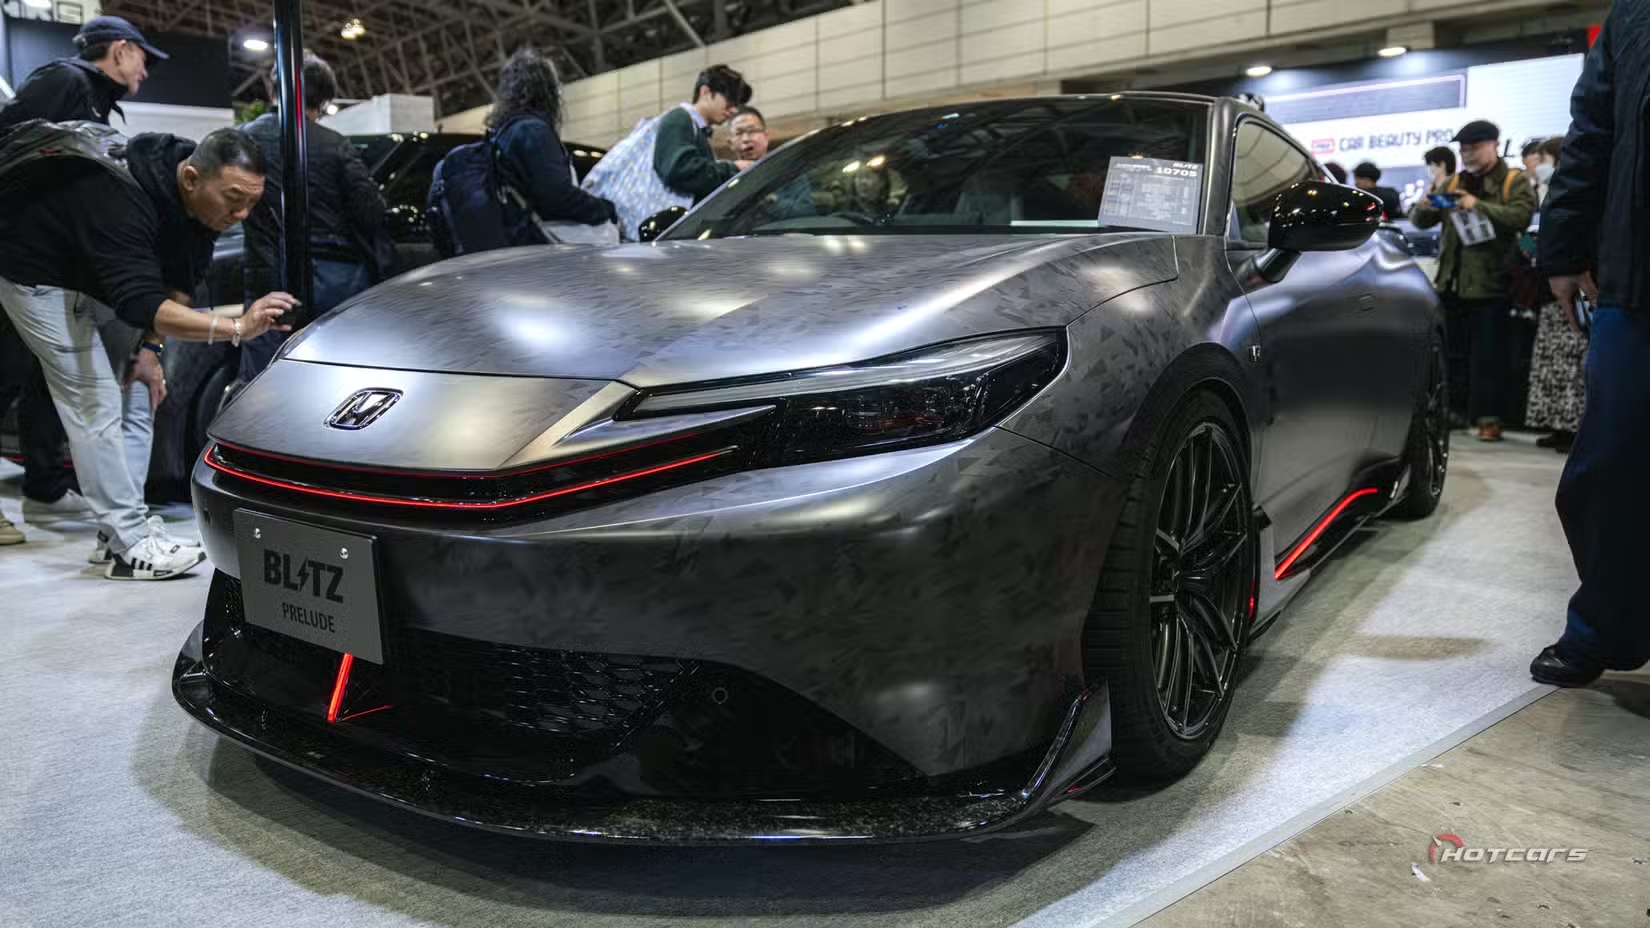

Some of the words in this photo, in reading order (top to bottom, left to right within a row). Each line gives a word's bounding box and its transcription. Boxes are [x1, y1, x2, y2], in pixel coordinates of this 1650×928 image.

[1339, 136, 1364, 151] CAR
[1369, 131, 1422, 149] BEAUTY
[264, 549, 345, 604] BLITZ
[282, 602, 336, 633] PRELUDE
